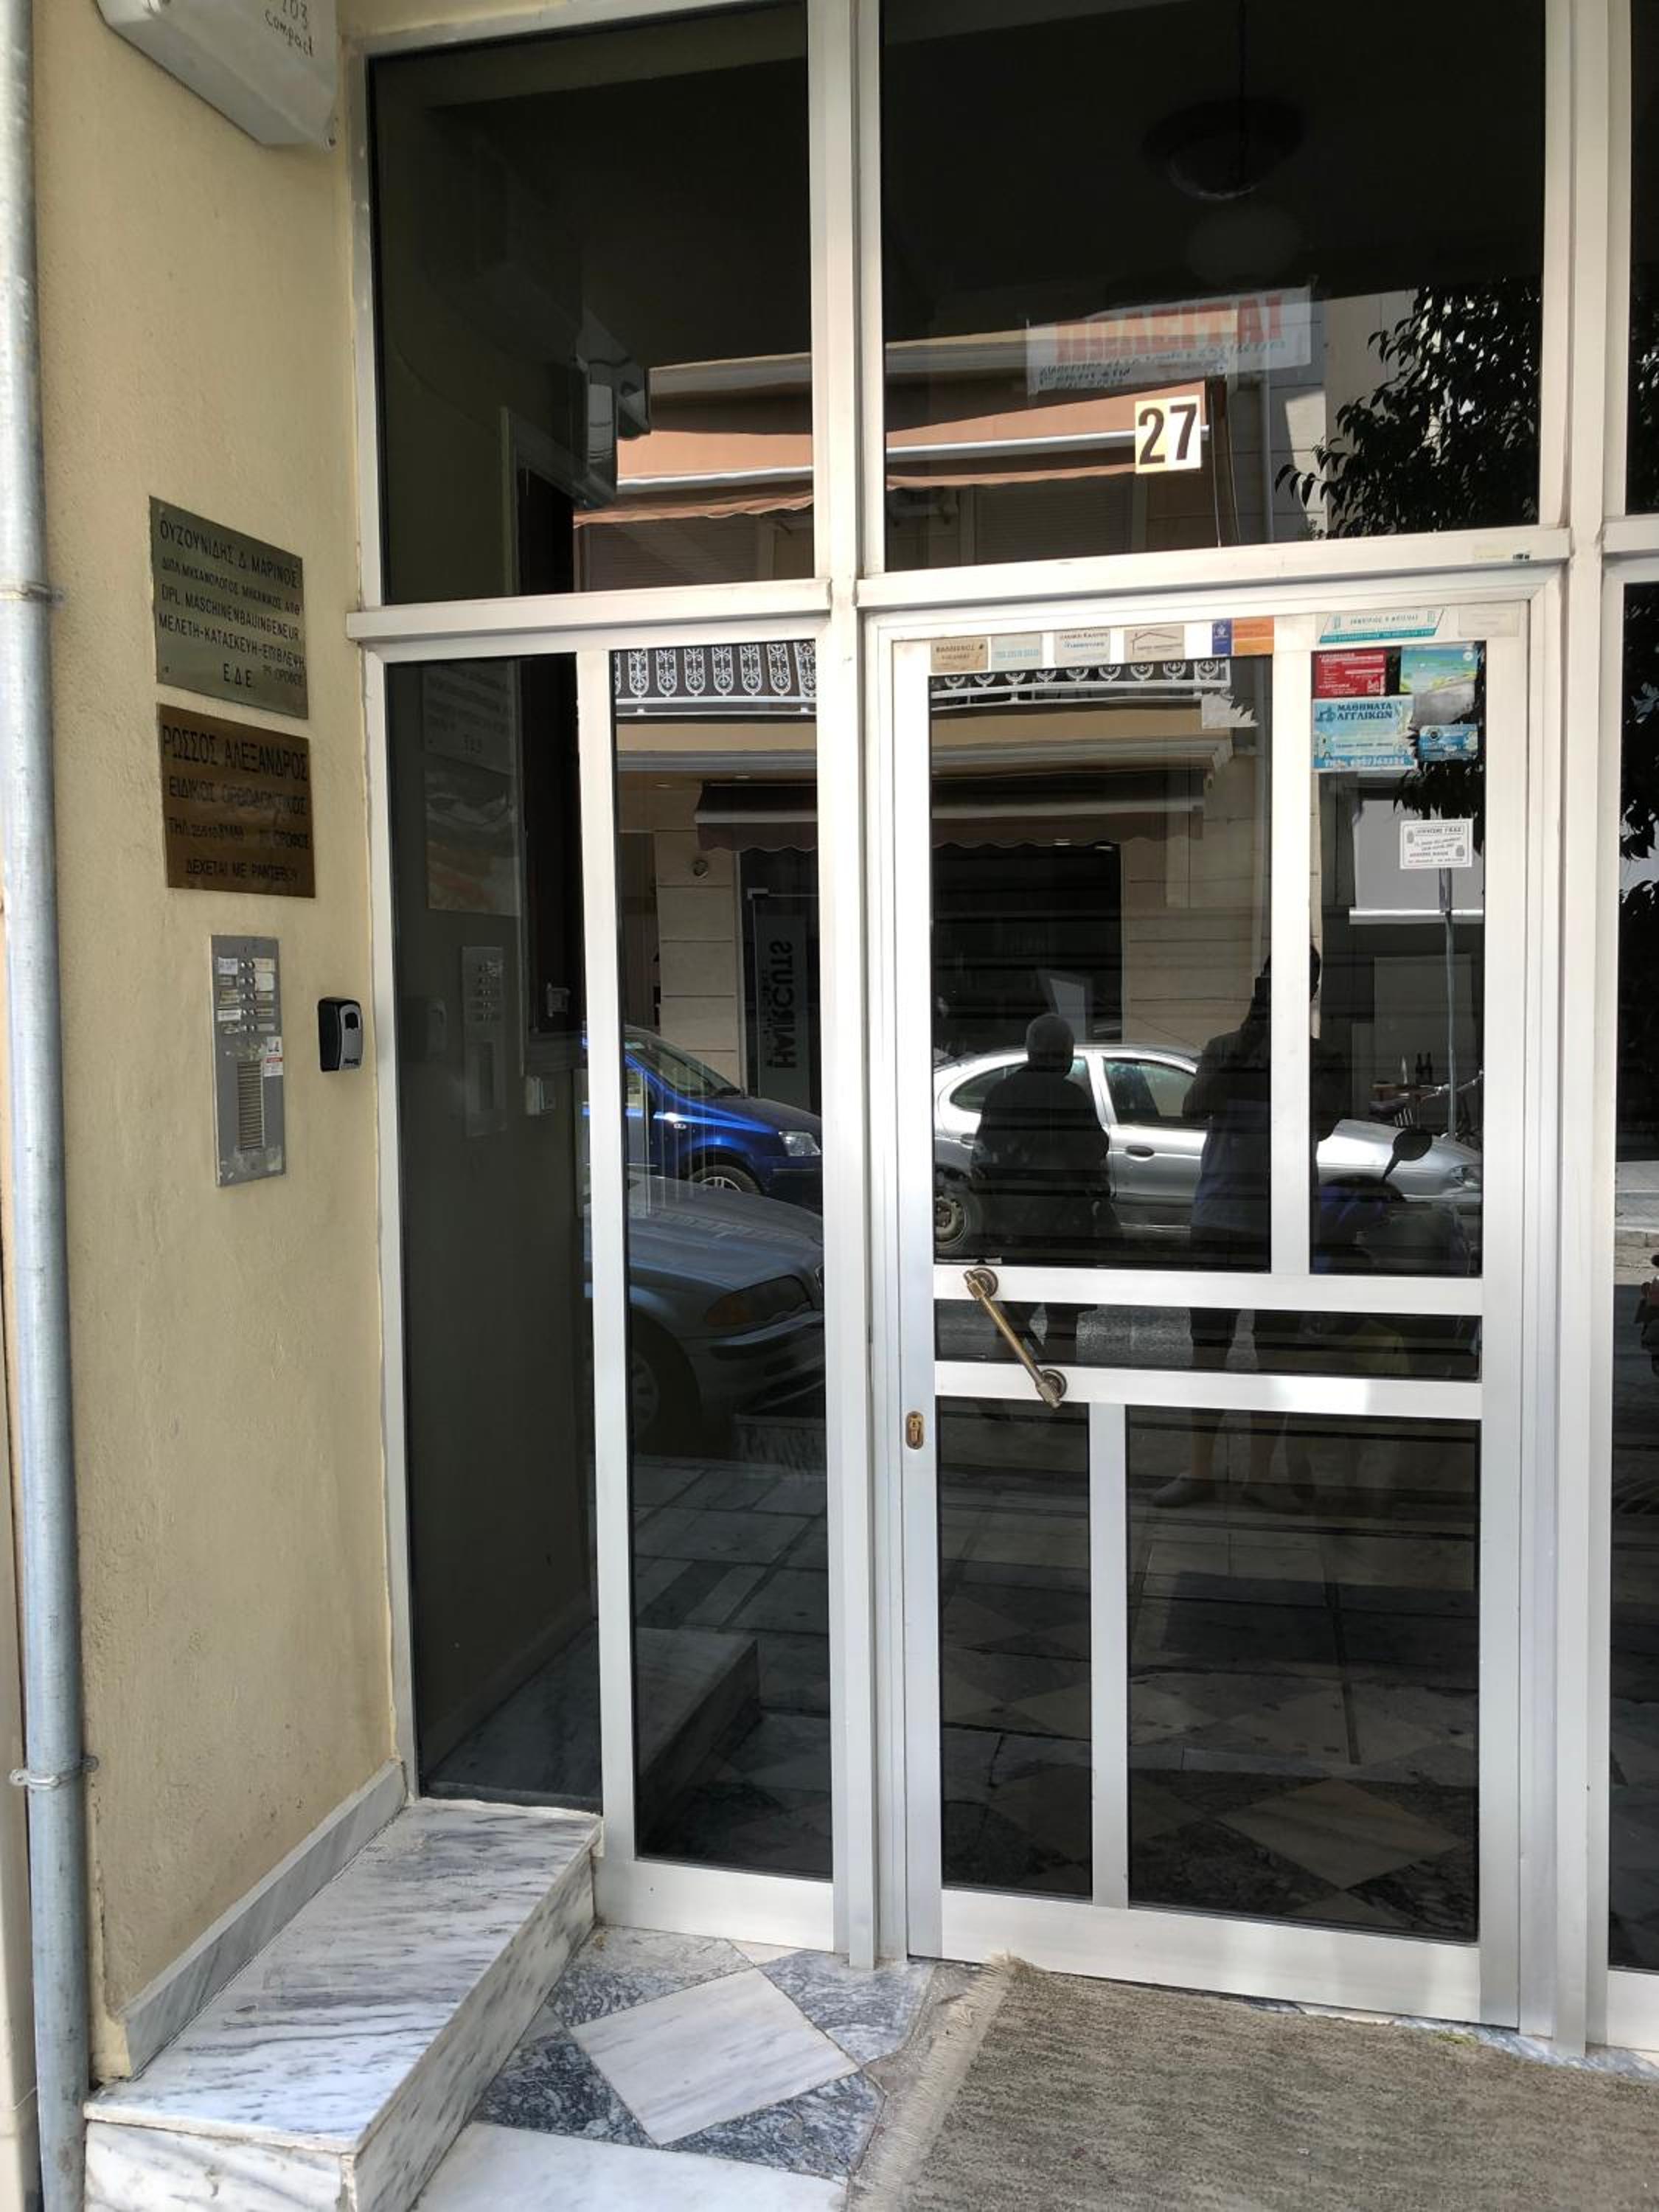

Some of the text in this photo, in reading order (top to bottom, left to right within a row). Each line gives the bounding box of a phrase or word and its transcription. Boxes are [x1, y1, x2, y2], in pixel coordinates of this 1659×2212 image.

[265, 10, 314, 57] Compact
[1138, 403, 1197, 465] 27
[159, 520, 235, 565] ΟΥΖΟΥΝΙΔΗΣ
[251, 557, 299, 588] ΜΑΡΙΝΟΣ
[1336, 711, 1393, 721] ΑΓΓΛΙΚΩΝ
[1337, 703, 1393, 712] ΜΑΘΗΜΑΤΑ
[161, 725, 307, 782] ΡΩΣΣΟΣ ΑΛΕΞΑΝΔΡΟΣ
